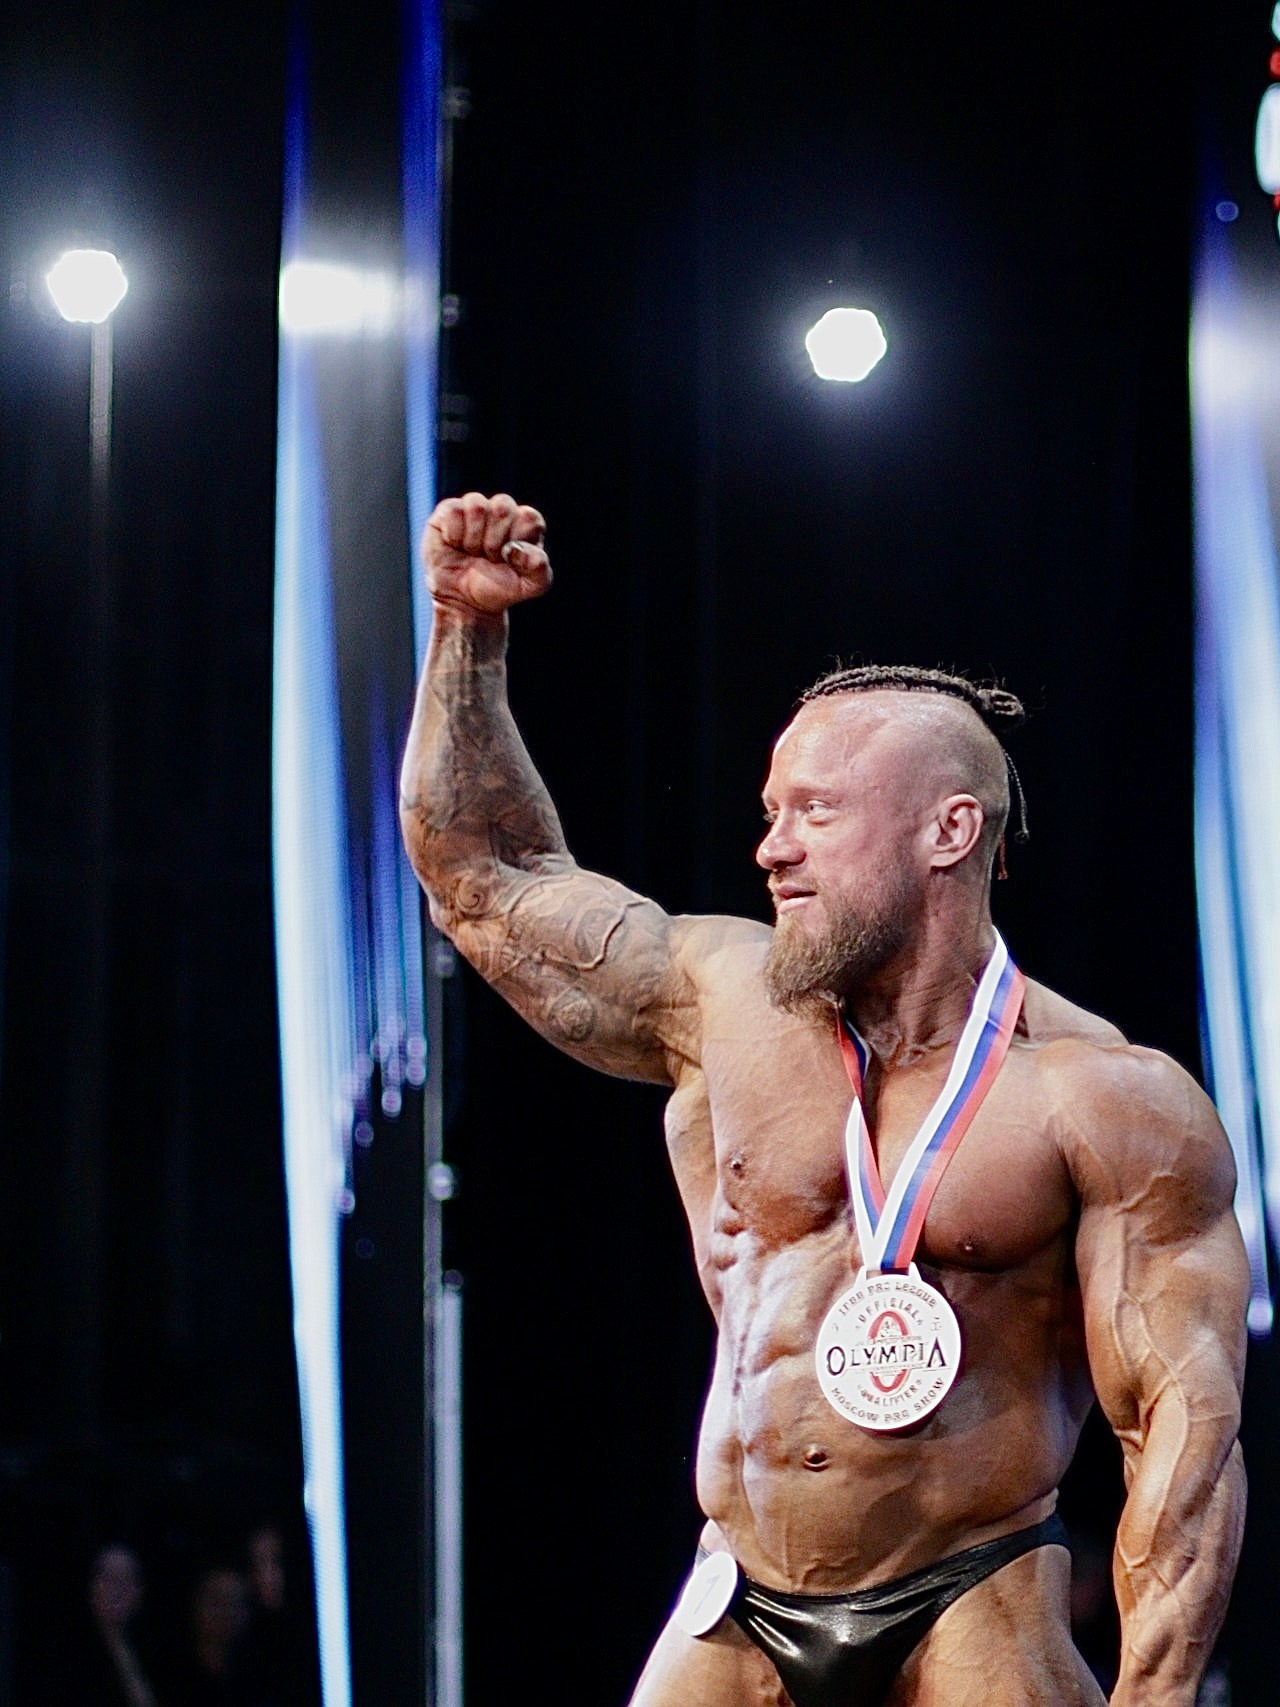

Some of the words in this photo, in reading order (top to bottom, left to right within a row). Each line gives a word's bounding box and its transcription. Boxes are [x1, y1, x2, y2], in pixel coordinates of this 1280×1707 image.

[826, 1336, 947, 1376] OLYMPIA
[831, 1387, 879, 1422] MOSCOW
[884, 1409, 911, 1422] PRO
[915, 1377, 945, 1411] SHOW
